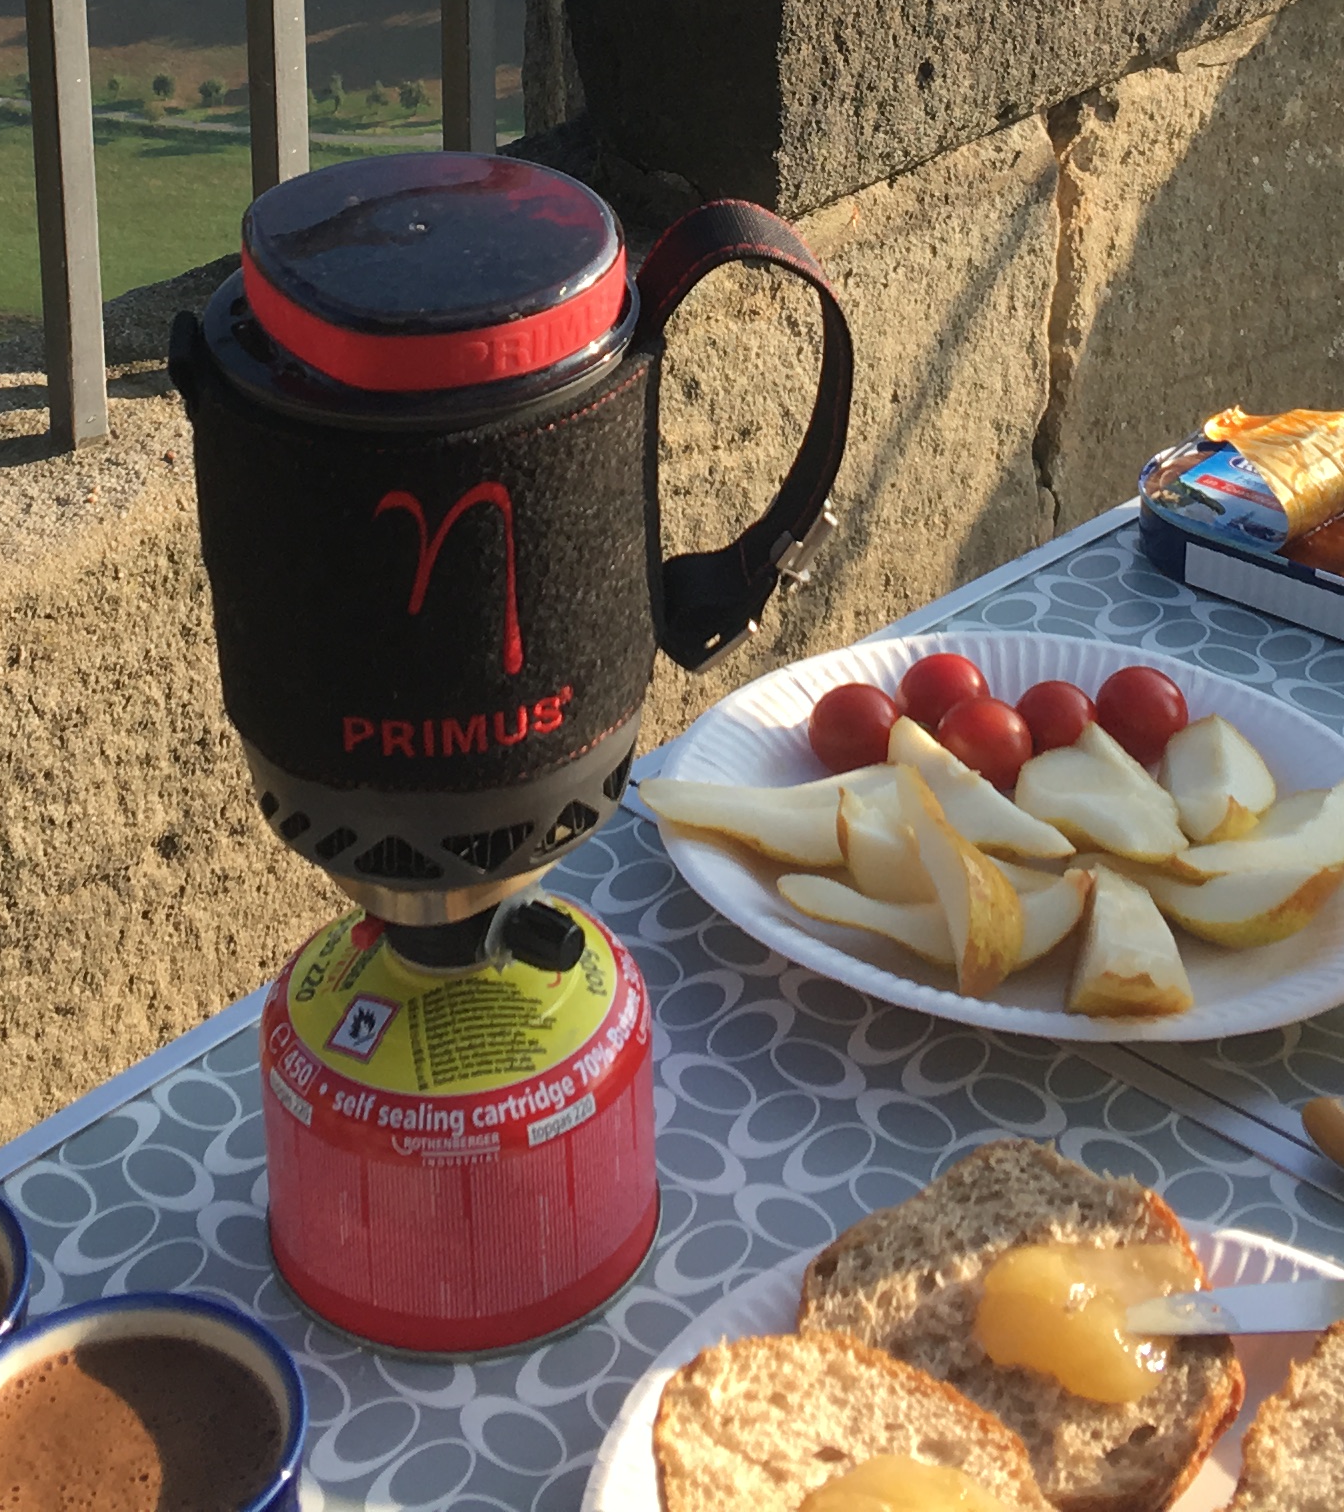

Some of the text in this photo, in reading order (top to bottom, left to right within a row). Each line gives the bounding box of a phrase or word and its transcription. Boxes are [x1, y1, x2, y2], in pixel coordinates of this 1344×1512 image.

[283, 1049, 313, 1086] 450
[332, 1088, 377, 1122] self
[377, 1102, 464, 1137] sealing
[472, 1075, 576, 1129] cartridge
[572, 1041, 615, 1087] 70%
[530, 1097, 594, 1141] topgas 220
